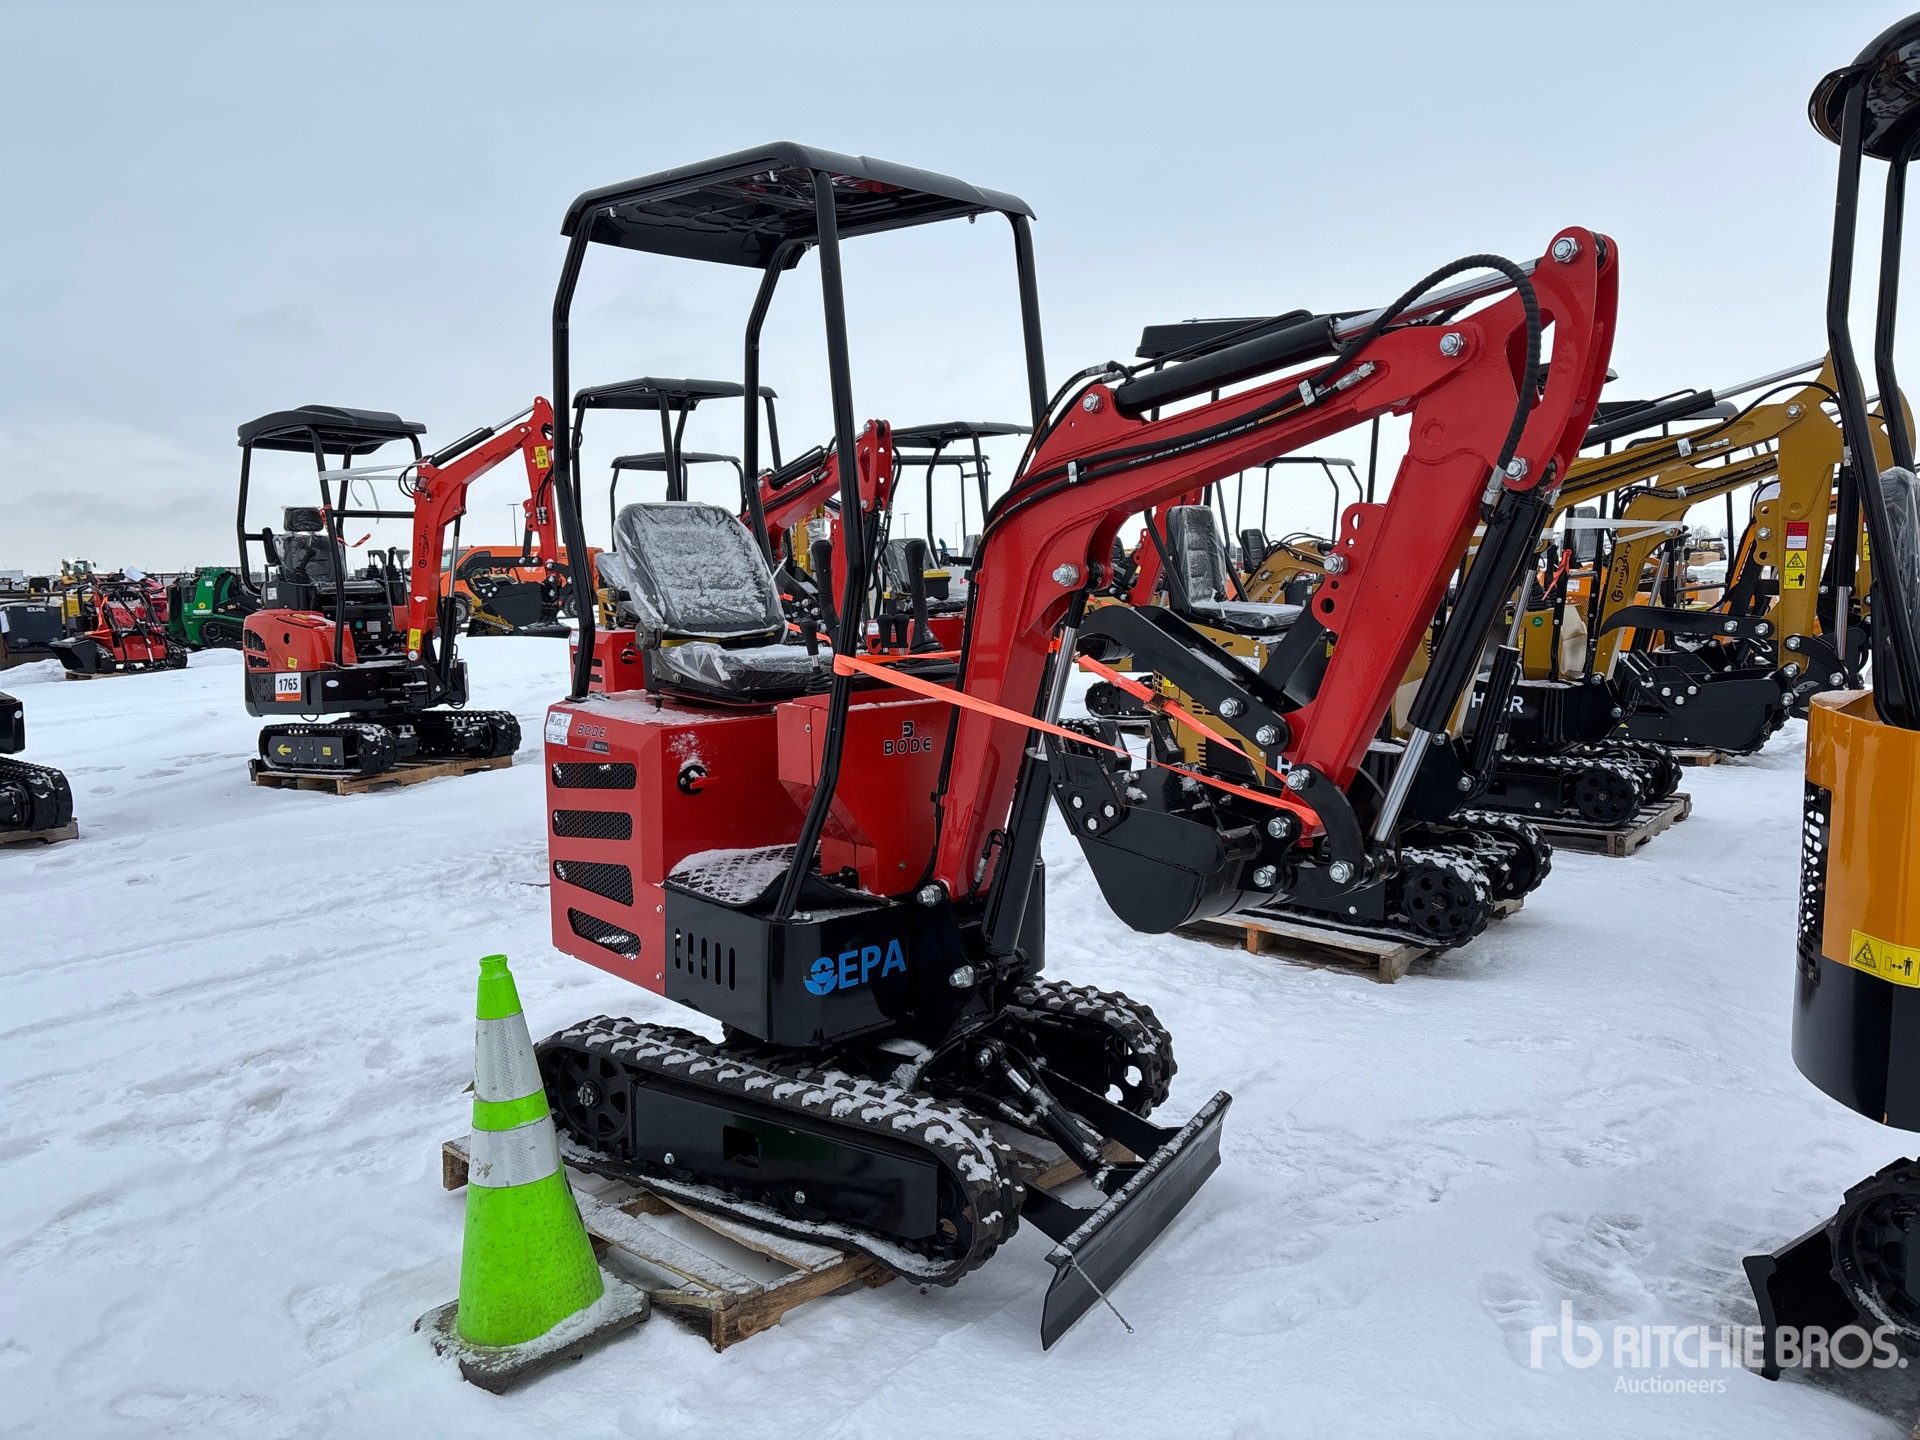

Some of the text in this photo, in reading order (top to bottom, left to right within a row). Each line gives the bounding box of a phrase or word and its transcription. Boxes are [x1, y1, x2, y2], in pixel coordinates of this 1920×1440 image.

[1615, 541, 1632, 589] Industry
[279, 677, 298, 691] 1765
[576, 723, 607, 739] BODE
[883, 736, 933, 756] BODE
[838, 939, 907, 990] EPA
